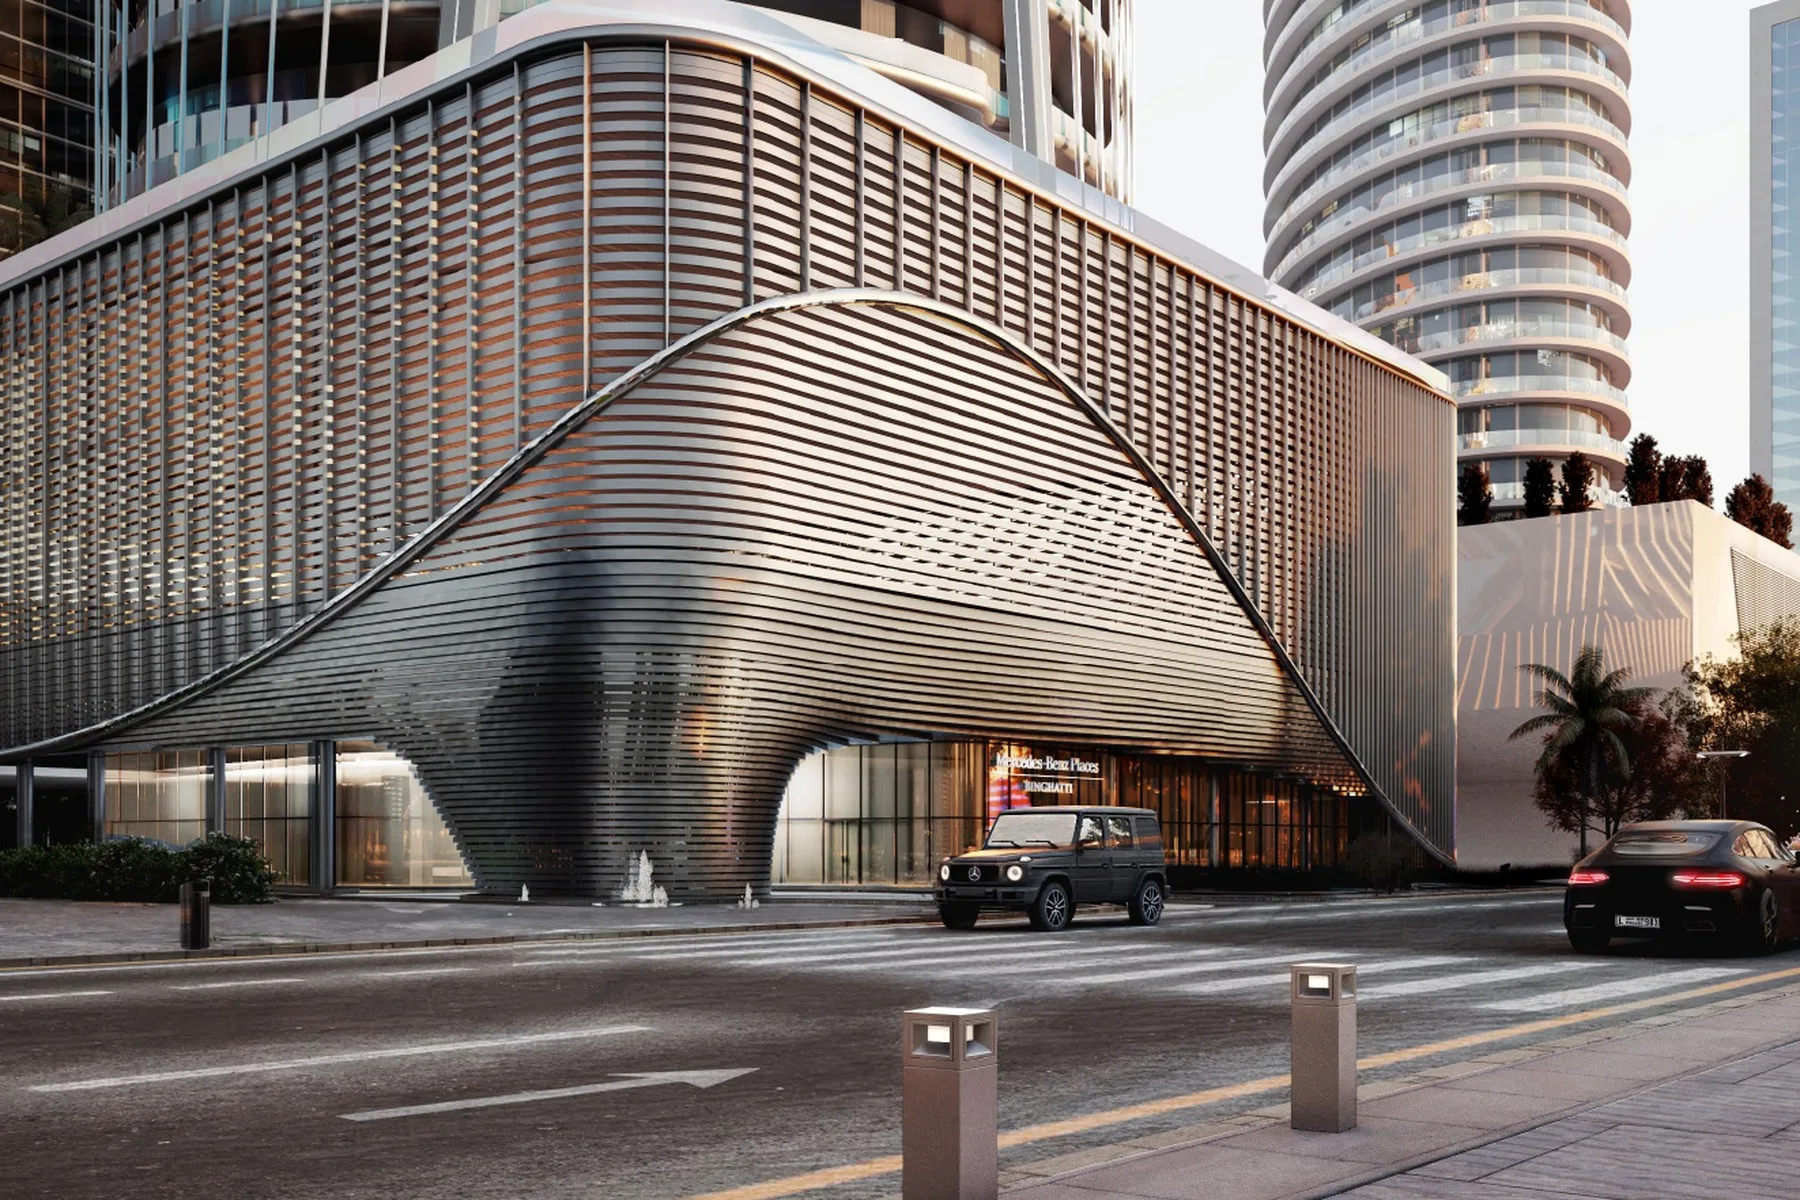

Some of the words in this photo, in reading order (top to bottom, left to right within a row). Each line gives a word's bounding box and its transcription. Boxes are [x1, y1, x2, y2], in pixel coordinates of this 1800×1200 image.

[996, 752, 1069, 771] Mercedes-Benz
[1070, 757, 1100, 774] Places
[1024, 780, 1073, 794] BINGHATTI
